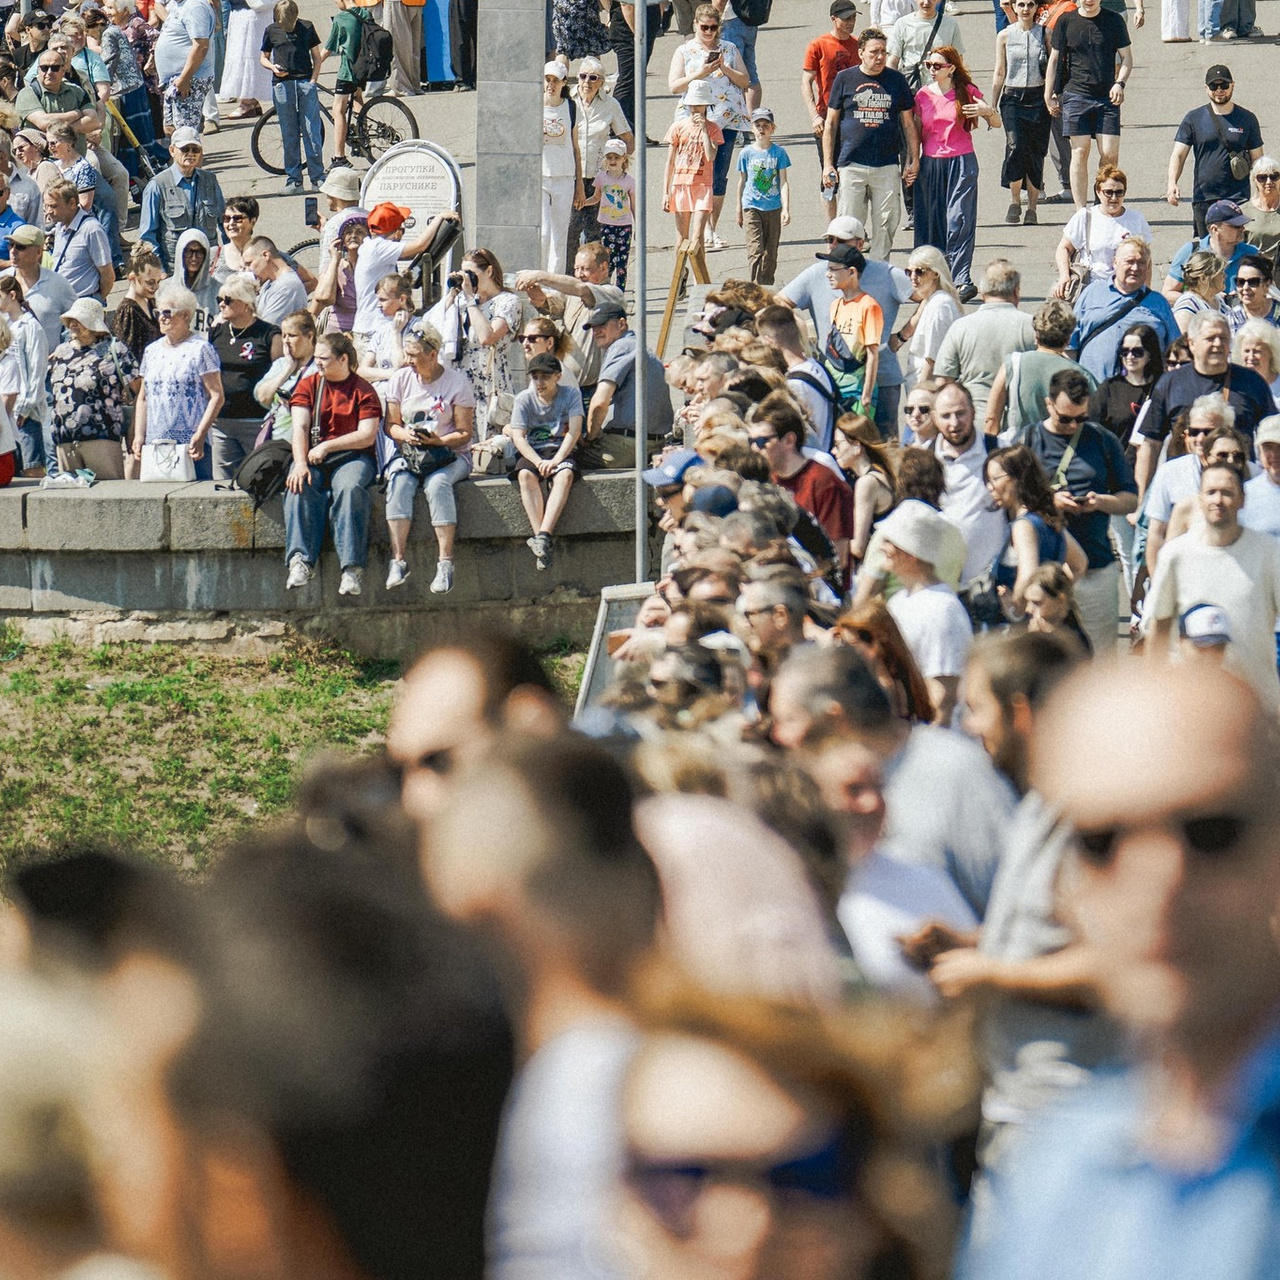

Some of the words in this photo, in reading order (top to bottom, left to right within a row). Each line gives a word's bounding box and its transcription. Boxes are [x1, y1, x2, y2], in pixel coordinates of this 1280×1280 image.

[853, 110, 864, 118] TOM
[864, 111, 883, 119] TAILOR
[385, 165, 435, 173] ПРОГУЛКИ
[379, 182, 438, 190] ПАРУСНИКЕ
